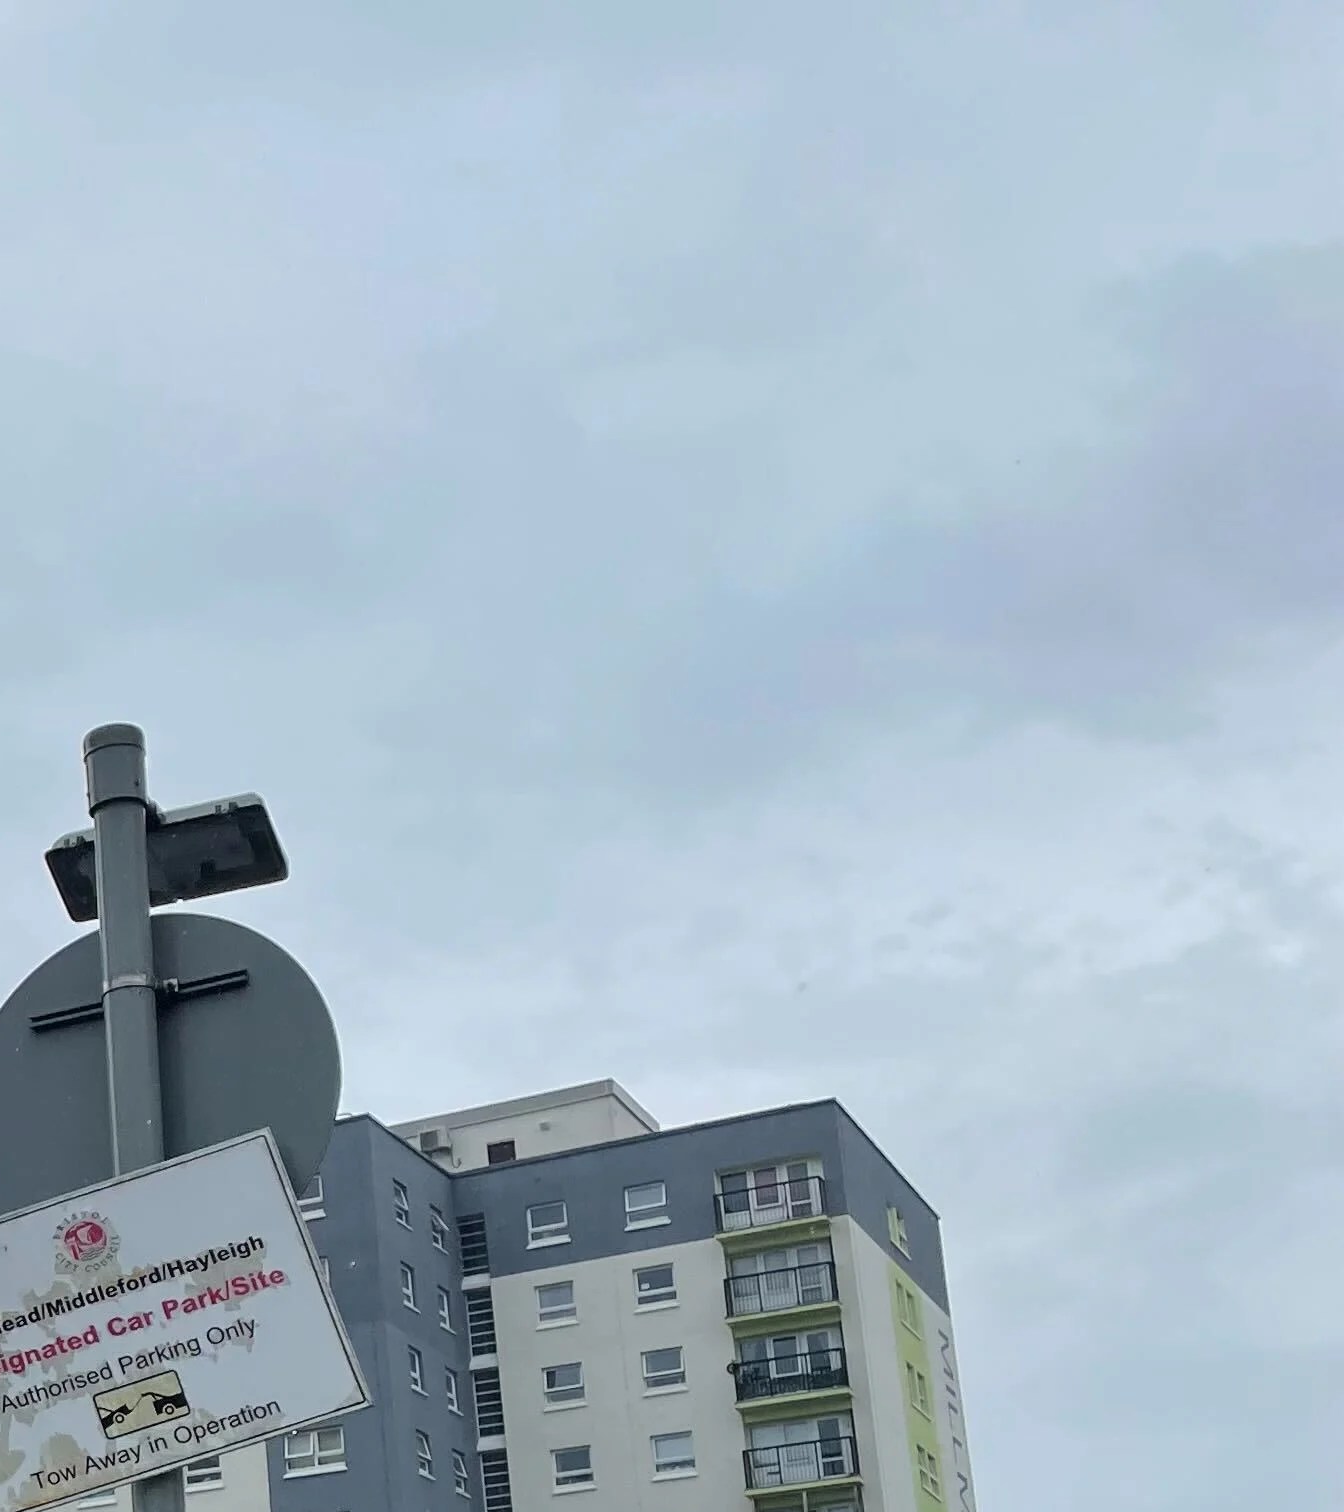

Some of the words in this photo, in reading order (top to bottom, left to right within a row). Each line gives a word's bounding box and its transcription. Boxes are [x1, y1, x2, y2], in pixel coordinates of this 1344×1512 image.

[55, 1252, 80, 1272] CITY
[84, 1234, 121, 1273] COUNCIL
[107, 1307, 154, 1348] Car
[162, 1265, 286, 1321] Park/Site
[1, 1361, 113, 1413] Authorised
[118, 1337, 202, 1381] Parking
[206, 1317, 257, 1352] Only
[31, 1464, 78, 1490] Tow
[85, 1446, 142, 1477] Away
[149, 1434, 169, 1453] in
[173, 1399, 282, 1446] Operation
